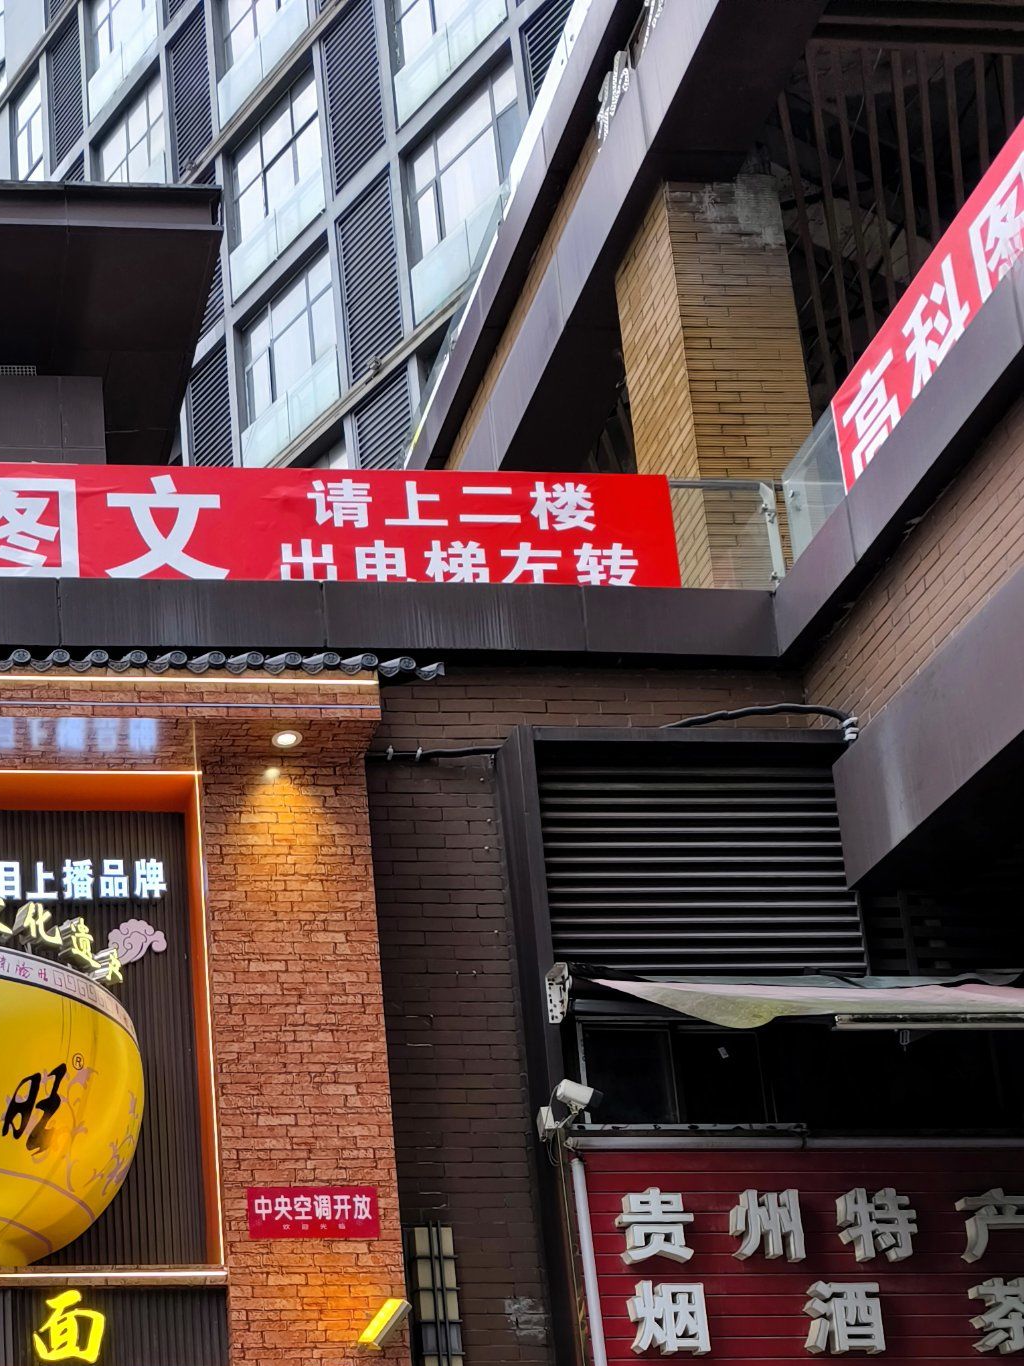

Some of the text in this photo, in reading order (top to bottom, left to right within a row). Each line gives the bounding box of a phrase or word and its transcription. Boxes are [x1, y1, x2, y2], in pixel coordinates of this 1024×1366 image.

[306, 478, 597, 531] 请上二楼
[280, 538, 639, 587] 出电梯左转
[254, 1194, 372, 1221] 中央空调开放
[614, 1186, 1024, 1266] 贵州特产
